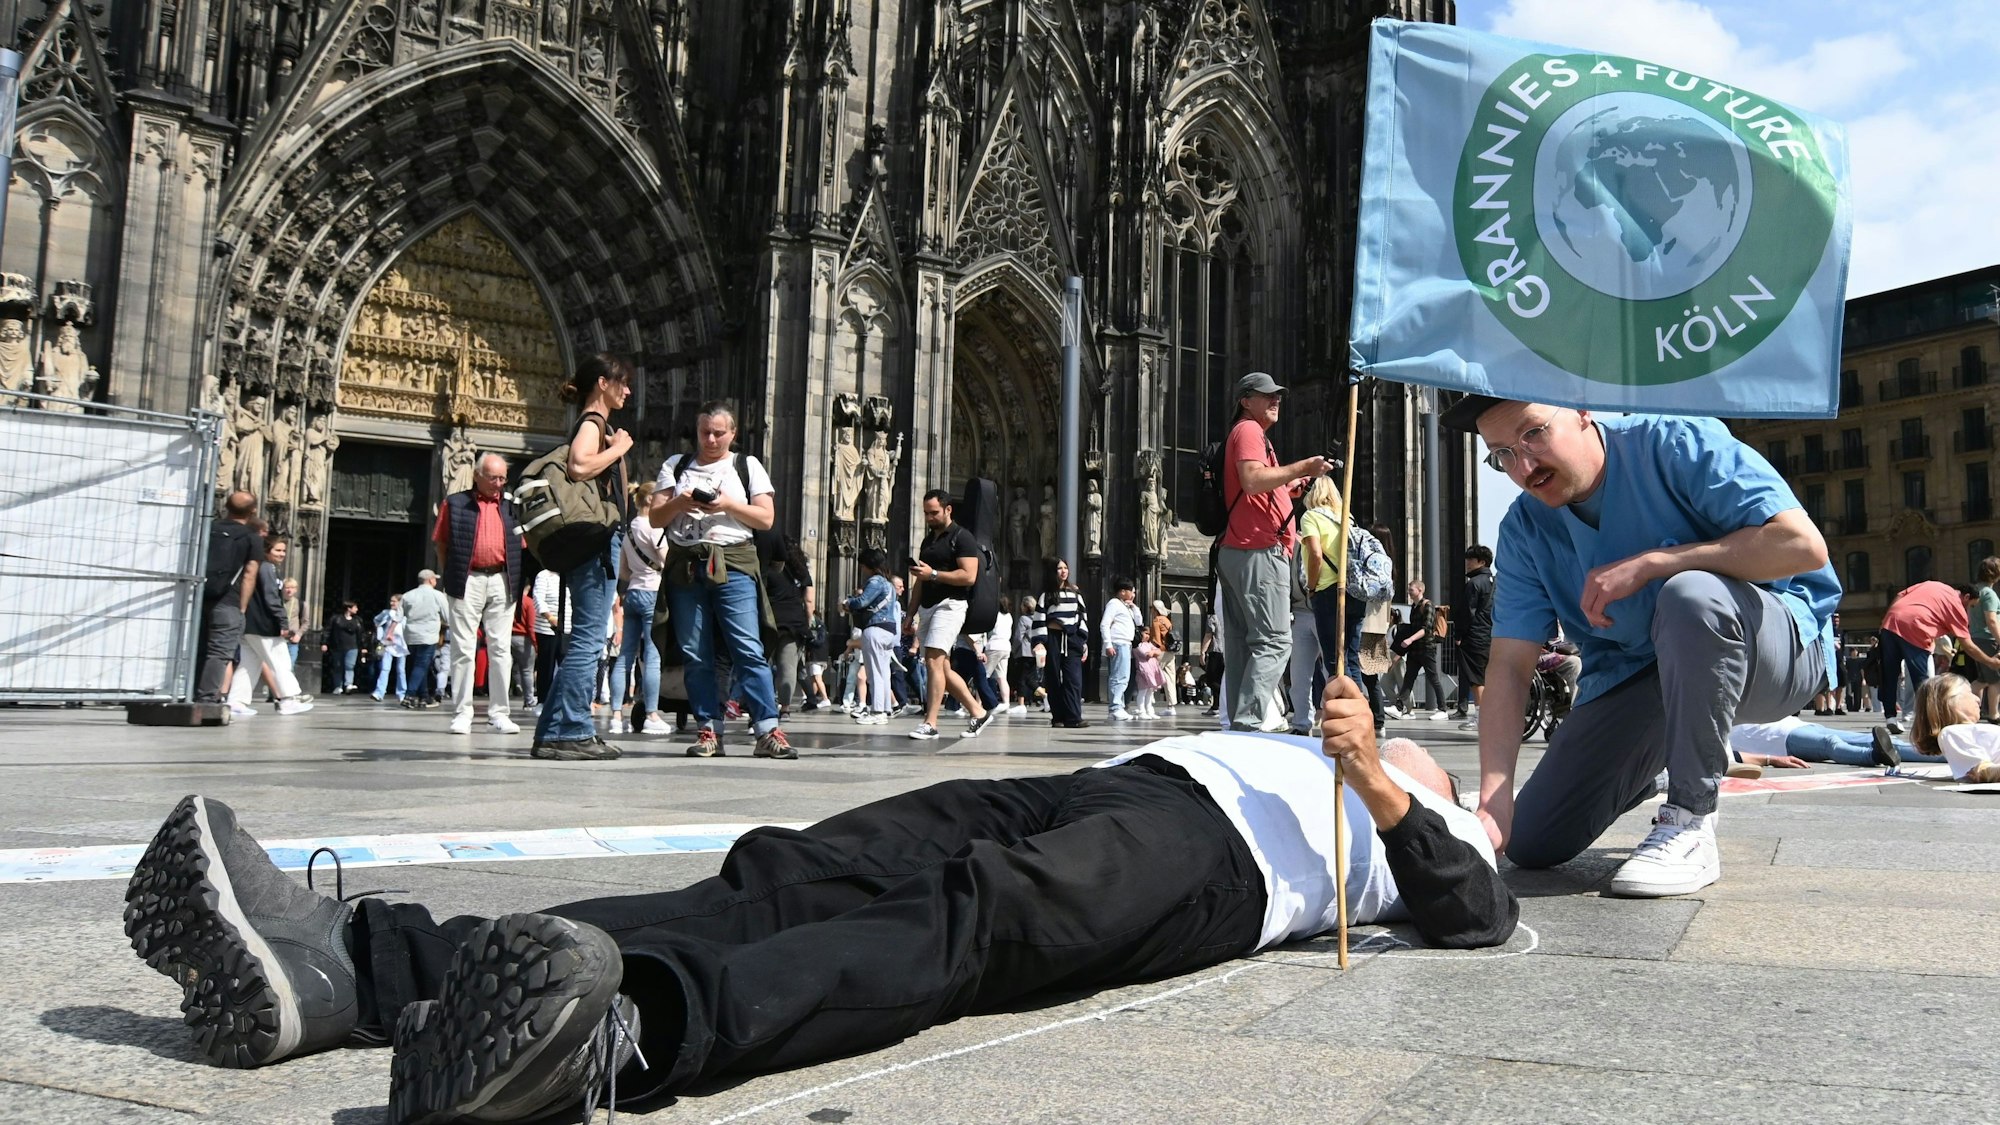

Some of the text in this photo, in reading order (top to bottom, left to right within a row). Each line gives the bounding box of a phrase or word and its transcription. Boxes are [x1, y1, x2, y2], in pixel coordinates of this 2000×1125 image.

[1470, 58, 1811, 318] GRANNIES 4 FUTURE
[1656, 275, 1776, 362] KÖLN
